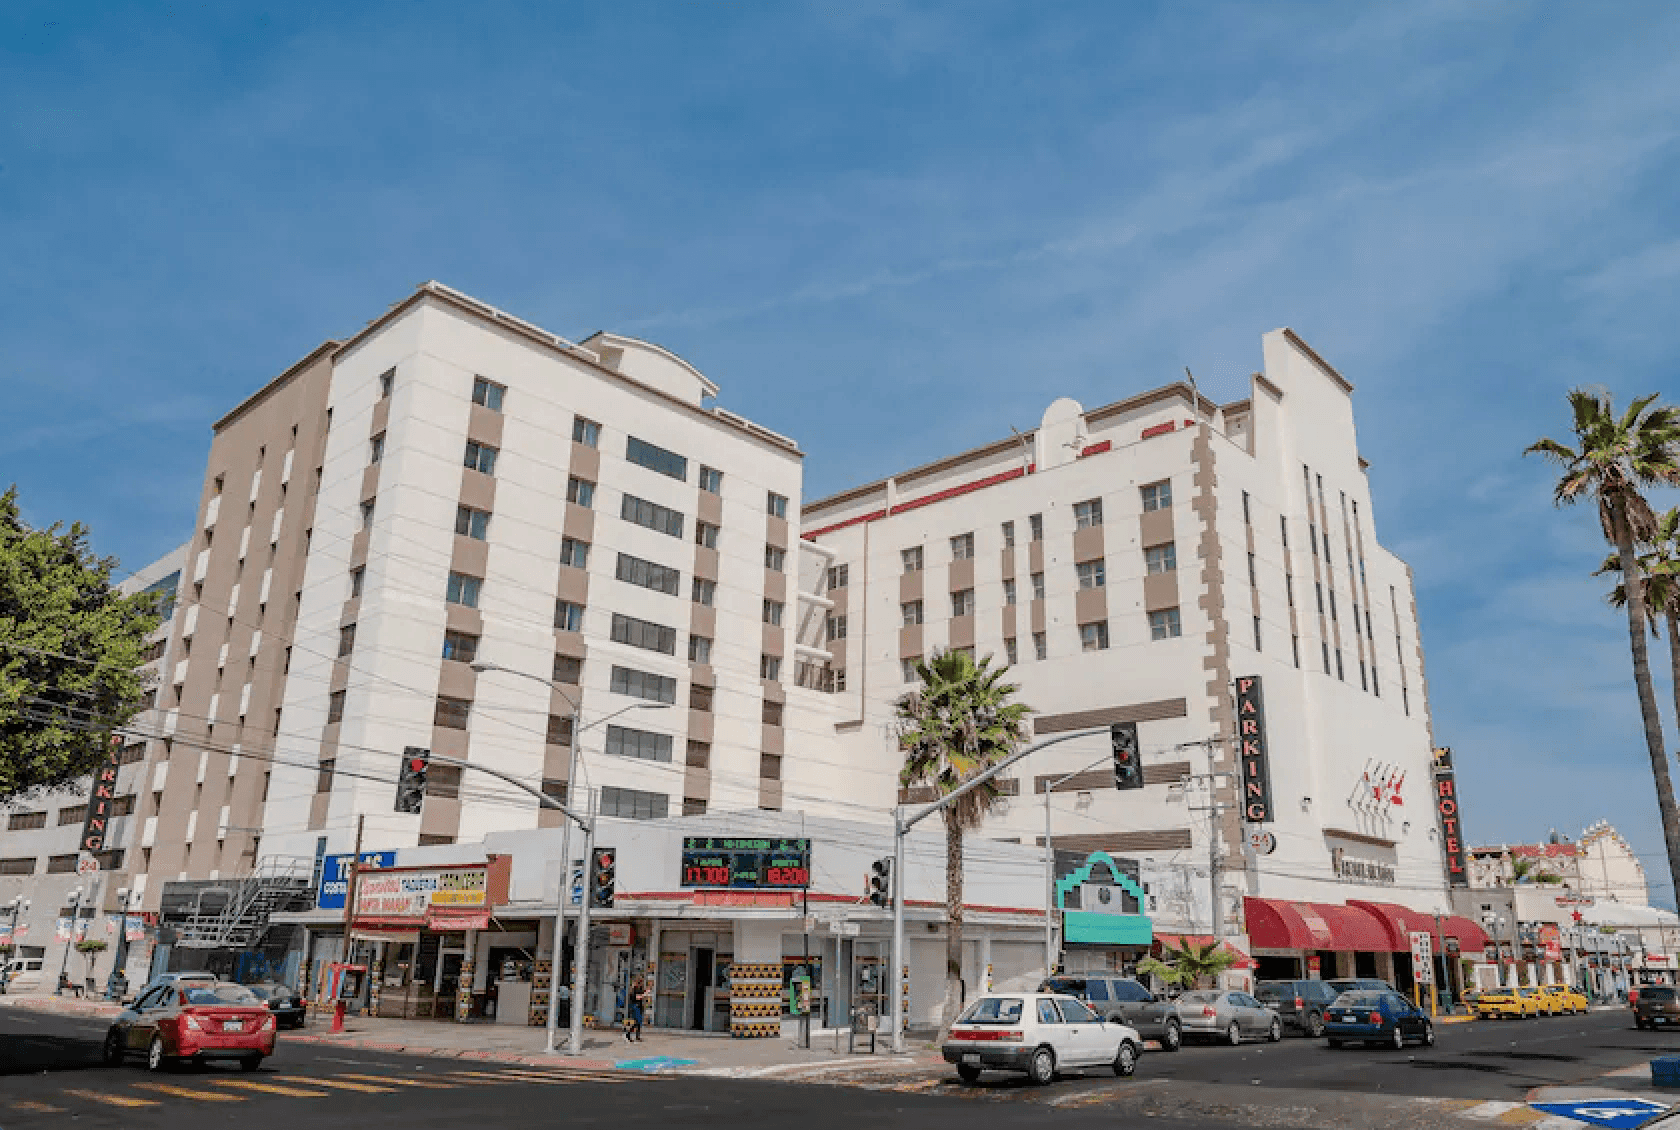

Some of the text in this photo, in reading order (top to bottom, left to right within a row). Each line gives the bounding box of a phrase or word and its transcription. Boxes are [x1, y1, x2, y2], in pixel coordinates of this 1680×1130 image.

[1239, 679, 1265, 820] PARKING
[1251, 833, 1270, 848] 24
[1438, 780, 1463, 873] HOTEL
[79, 859, 98, 872] 24
